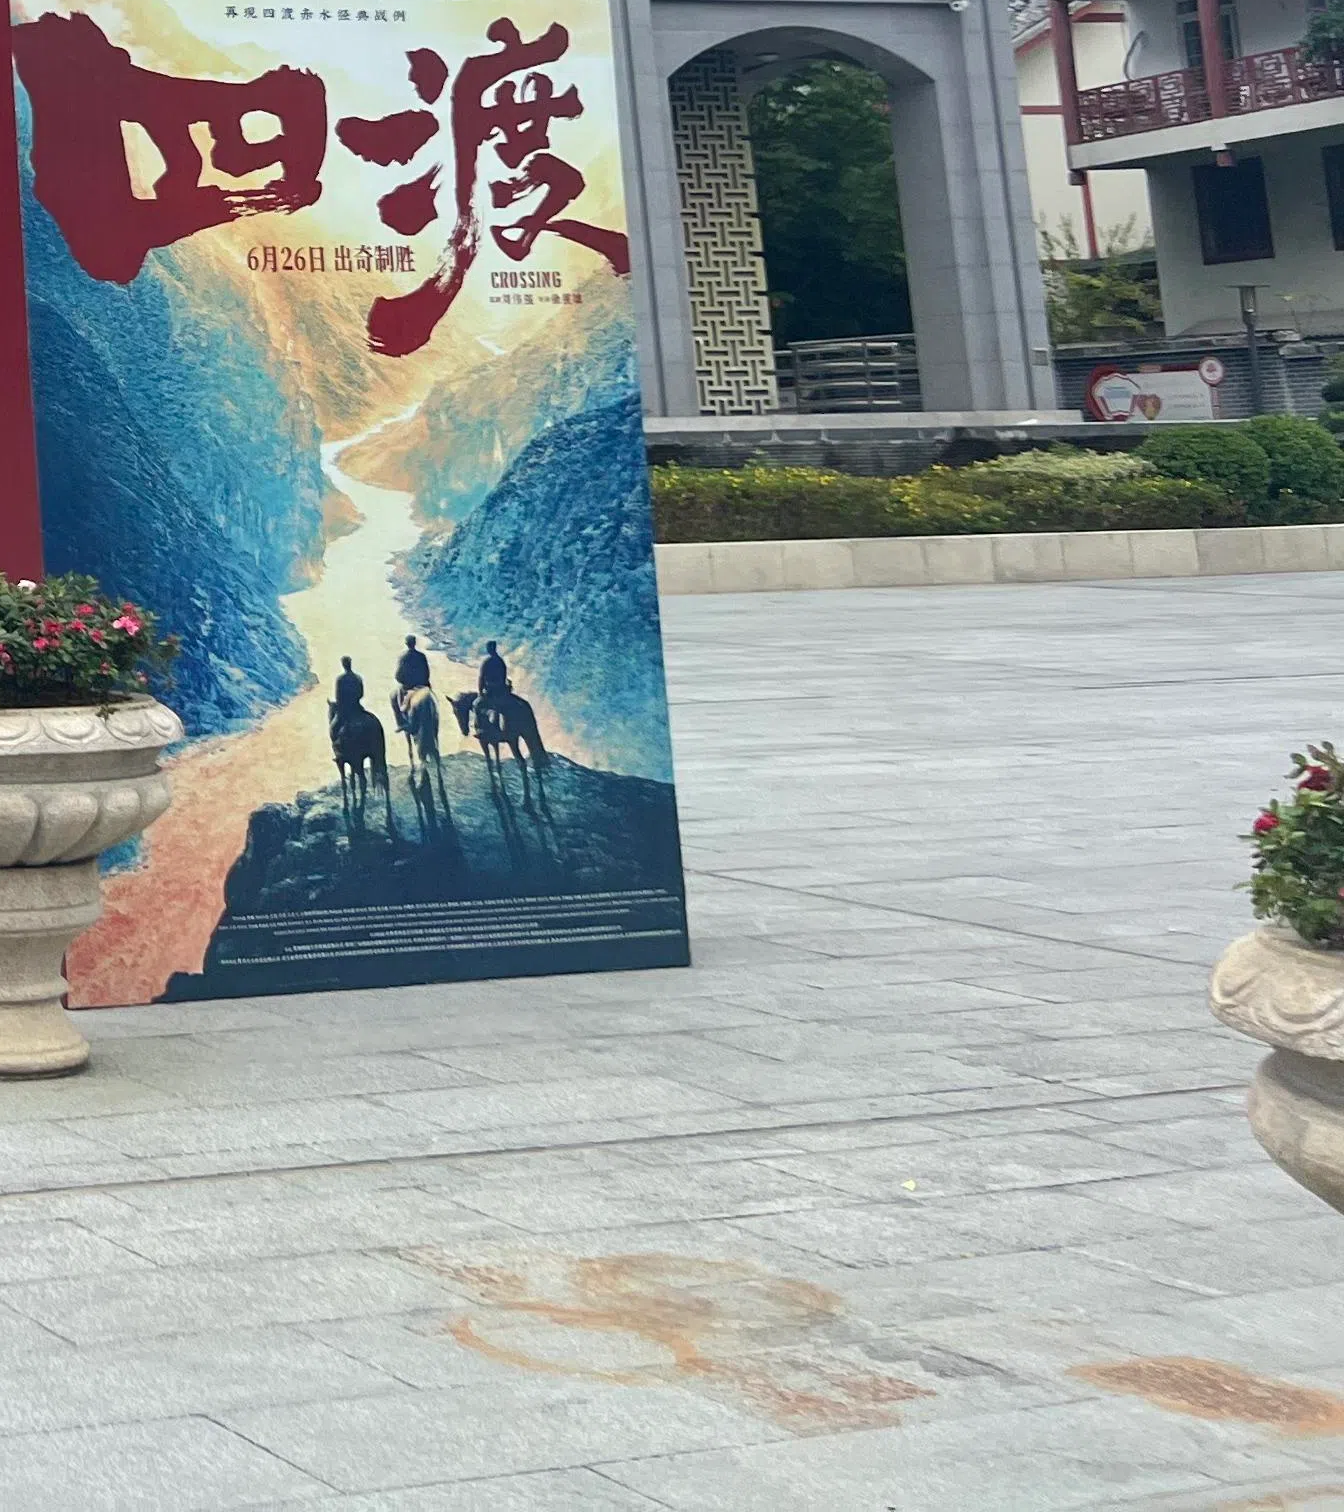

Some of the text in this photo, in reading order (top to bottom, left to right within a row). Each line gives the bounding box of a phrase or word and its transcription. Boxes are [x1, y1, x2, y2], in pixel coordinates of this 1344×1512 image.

[224, 5, 406, 23] 再现四渡赤水经典战例
[12, 11, 630, 356] 四渡
[247, 244, 417, 273] 6月26日 出奇制胜
[490, 271, 562, 289] CROSSING
